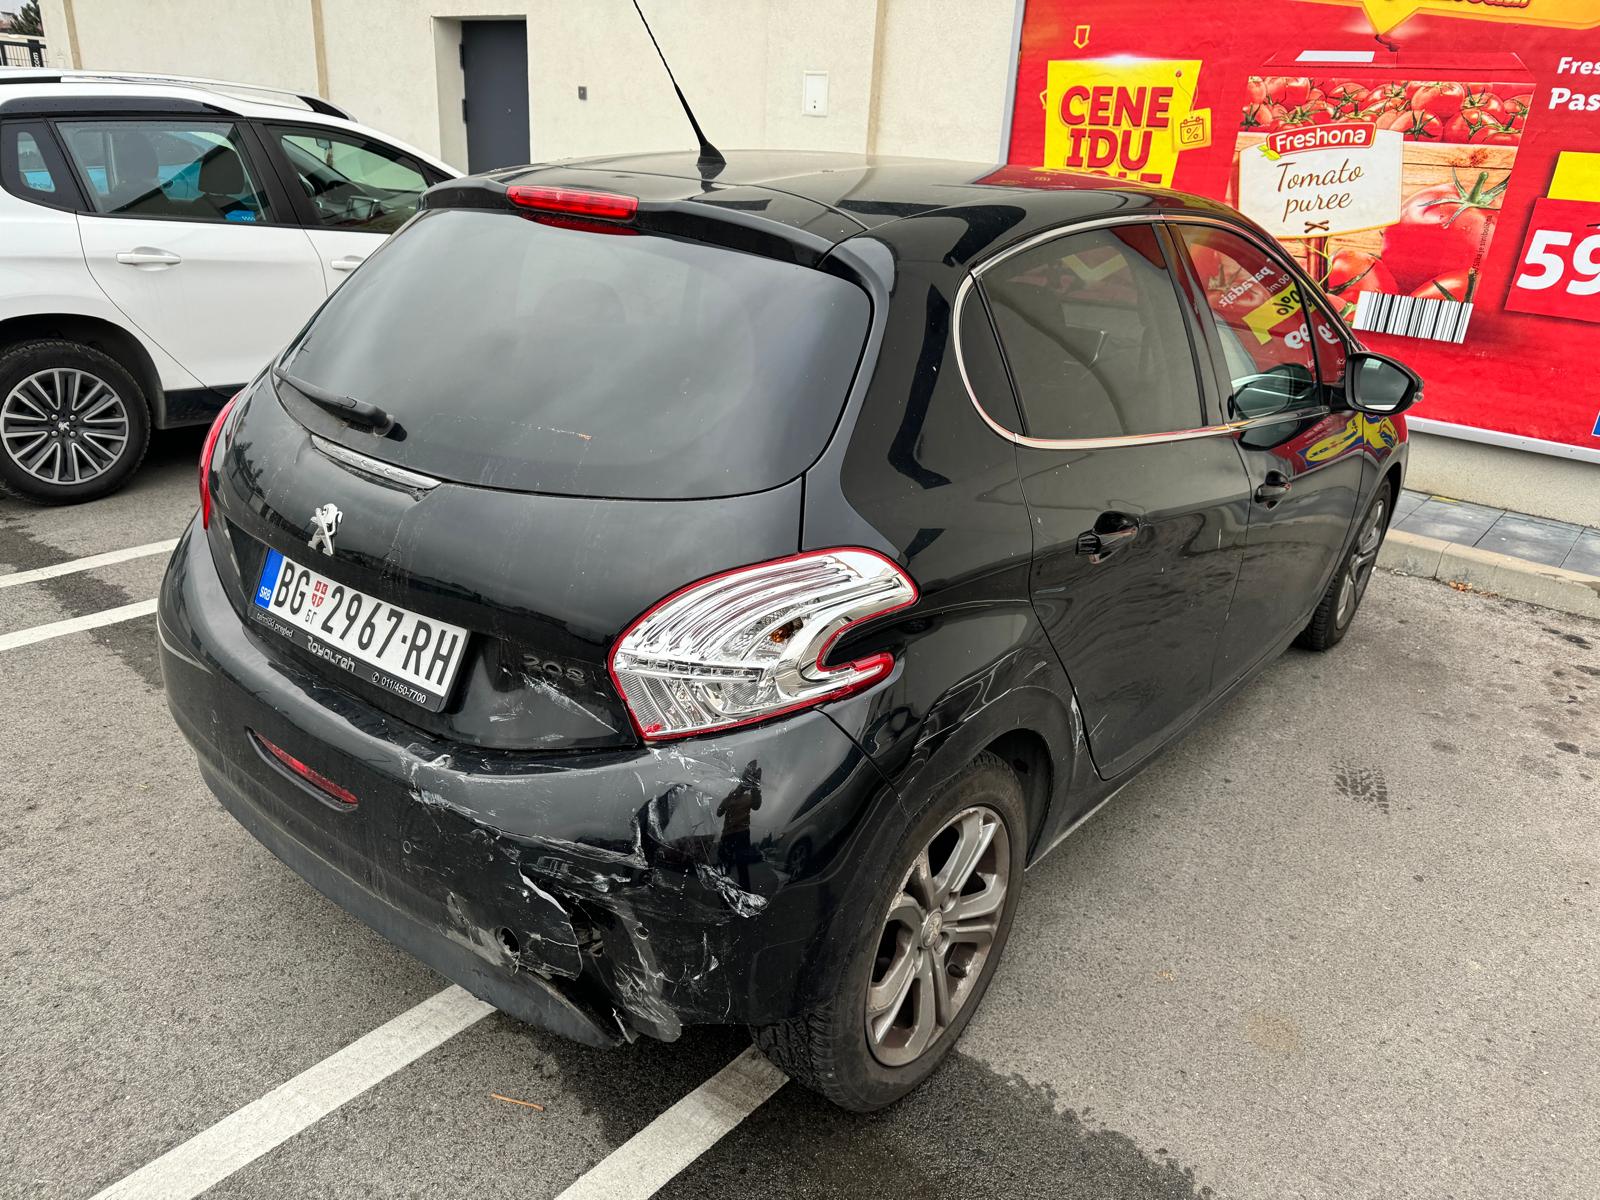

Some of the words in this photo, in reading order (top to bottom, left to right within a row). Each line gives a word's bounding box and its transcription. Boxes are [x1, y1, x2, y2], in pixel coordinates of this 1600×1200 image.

[1061, 85, 1173, 128] CENE
[1548, 87, 1600, 111] Pas
[1066, 128, 1153, 171] IDU
[1276, 127, 1366, 152] Freshona
[1277, 158, 1364, 192] Tomato
[1282, 192, 1352, 222] puree
[1516, 229, 1600, 296] 59
[260, 586, 272, 601] SRB
[274, 562, 311, 615] BG
[381, 677, 427, 704] 011/450-7700
